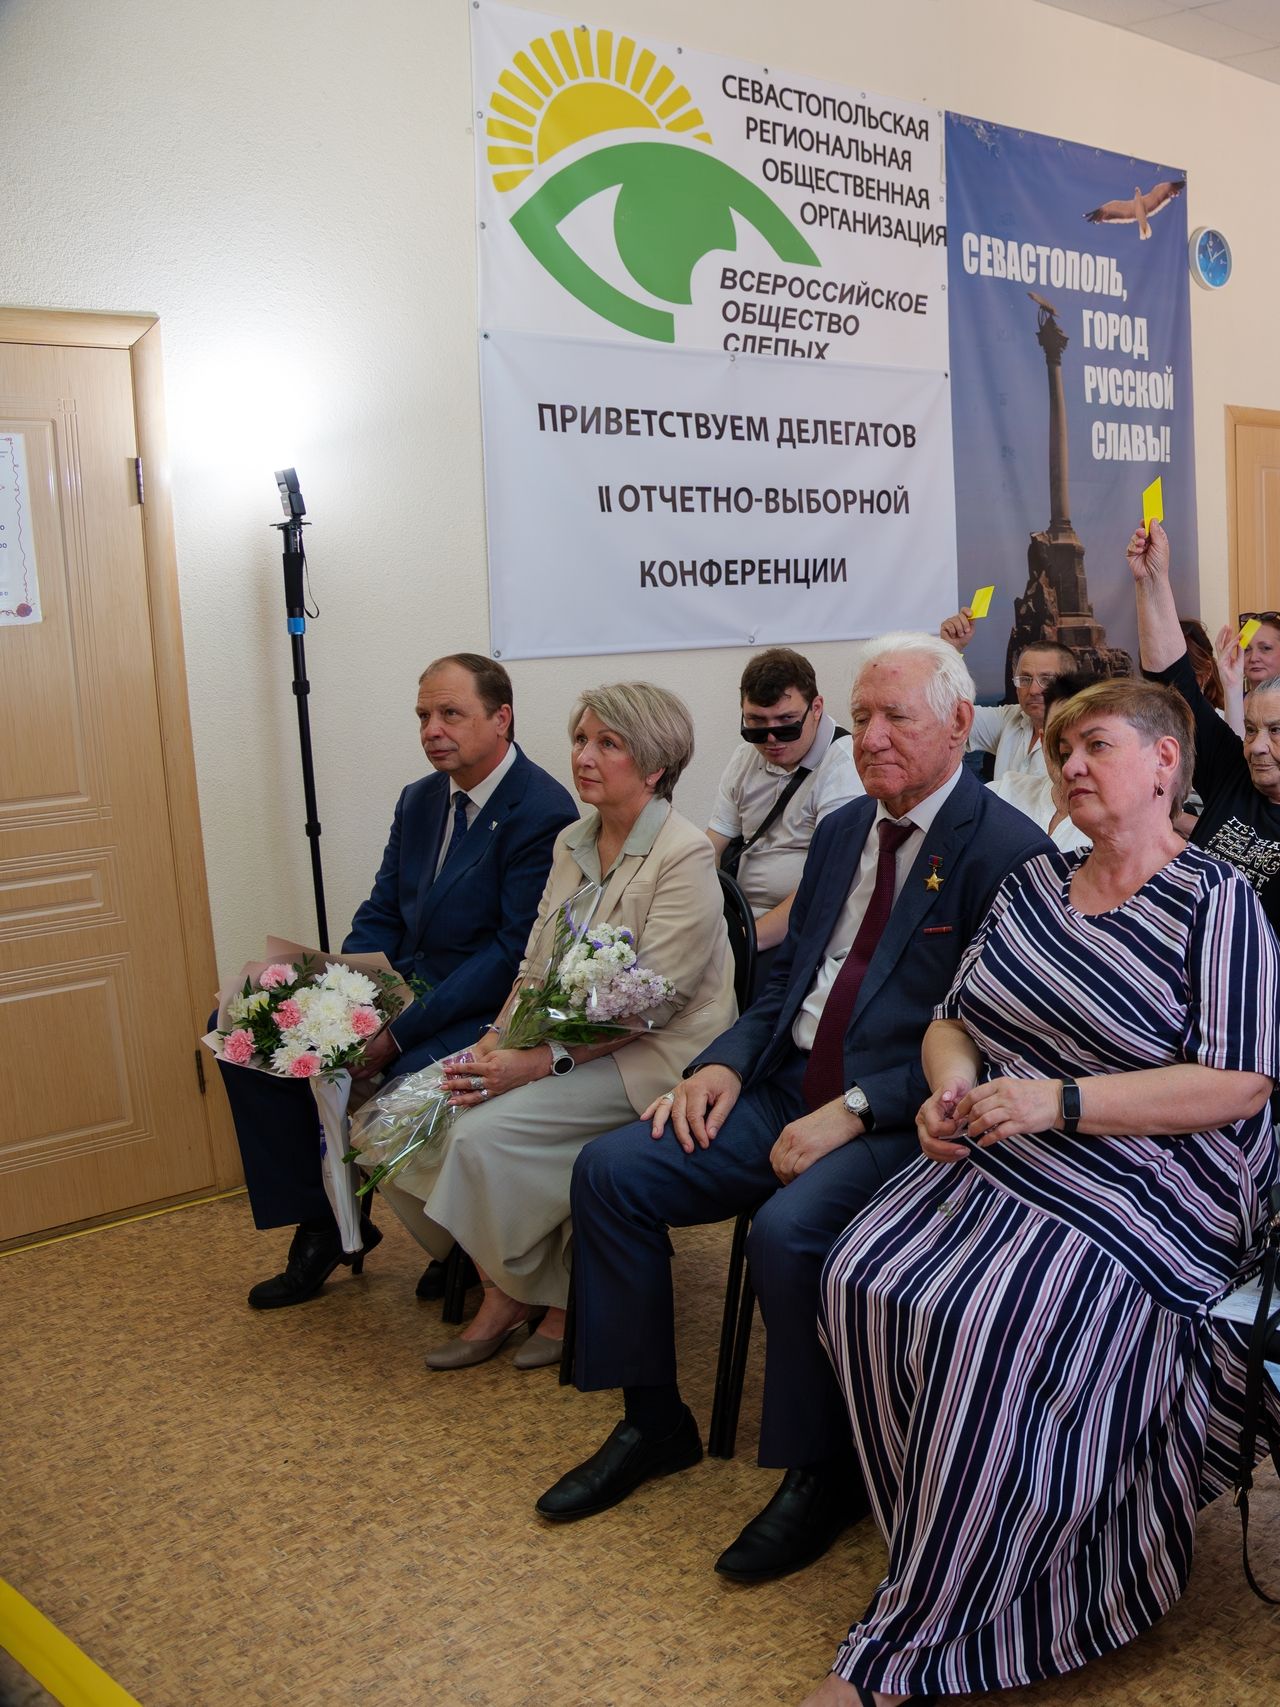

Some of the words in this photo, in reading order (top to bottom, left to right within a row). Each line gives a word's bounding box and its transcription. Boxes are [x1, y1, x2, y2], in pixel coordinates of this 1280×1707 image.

[722, 74, 929, 142] СЕВАСТОПОЛЬСКАЯ
[746, 116, 912, 172] РЕГИОНАЛЬНАЯ
[762, 158, 930, 210] ОБЩЕСТВЕННАЯ
[800, 201, 948, 247] ОРГАНИЗАЦИЯ
[962, 231, 1128, 302] СЕВАСТОПОЛЬ,
[719, 267, 928, 315] ВСЕРОССИЙСКОЕ
[721, 300, 860, 336] ОБЩЕСТВО
[1082, 309, 1149, 361] ГОРОД
[1084, 365, 1174, 410] РУССКОЙ
[537, 402, 769, 442] ПРИВЕТСТВУЕМ
[776, 417, 917, 449] ДЕЛЕГАТОВ
[1092, 420, 1171, 463] СЛАВЫ!
[618, 485, 910, 514] ОТЧЕТНО-ВЫБОРНОЙ
[639, 557, 848, 589] КОНФЕРЕНЦИИ
